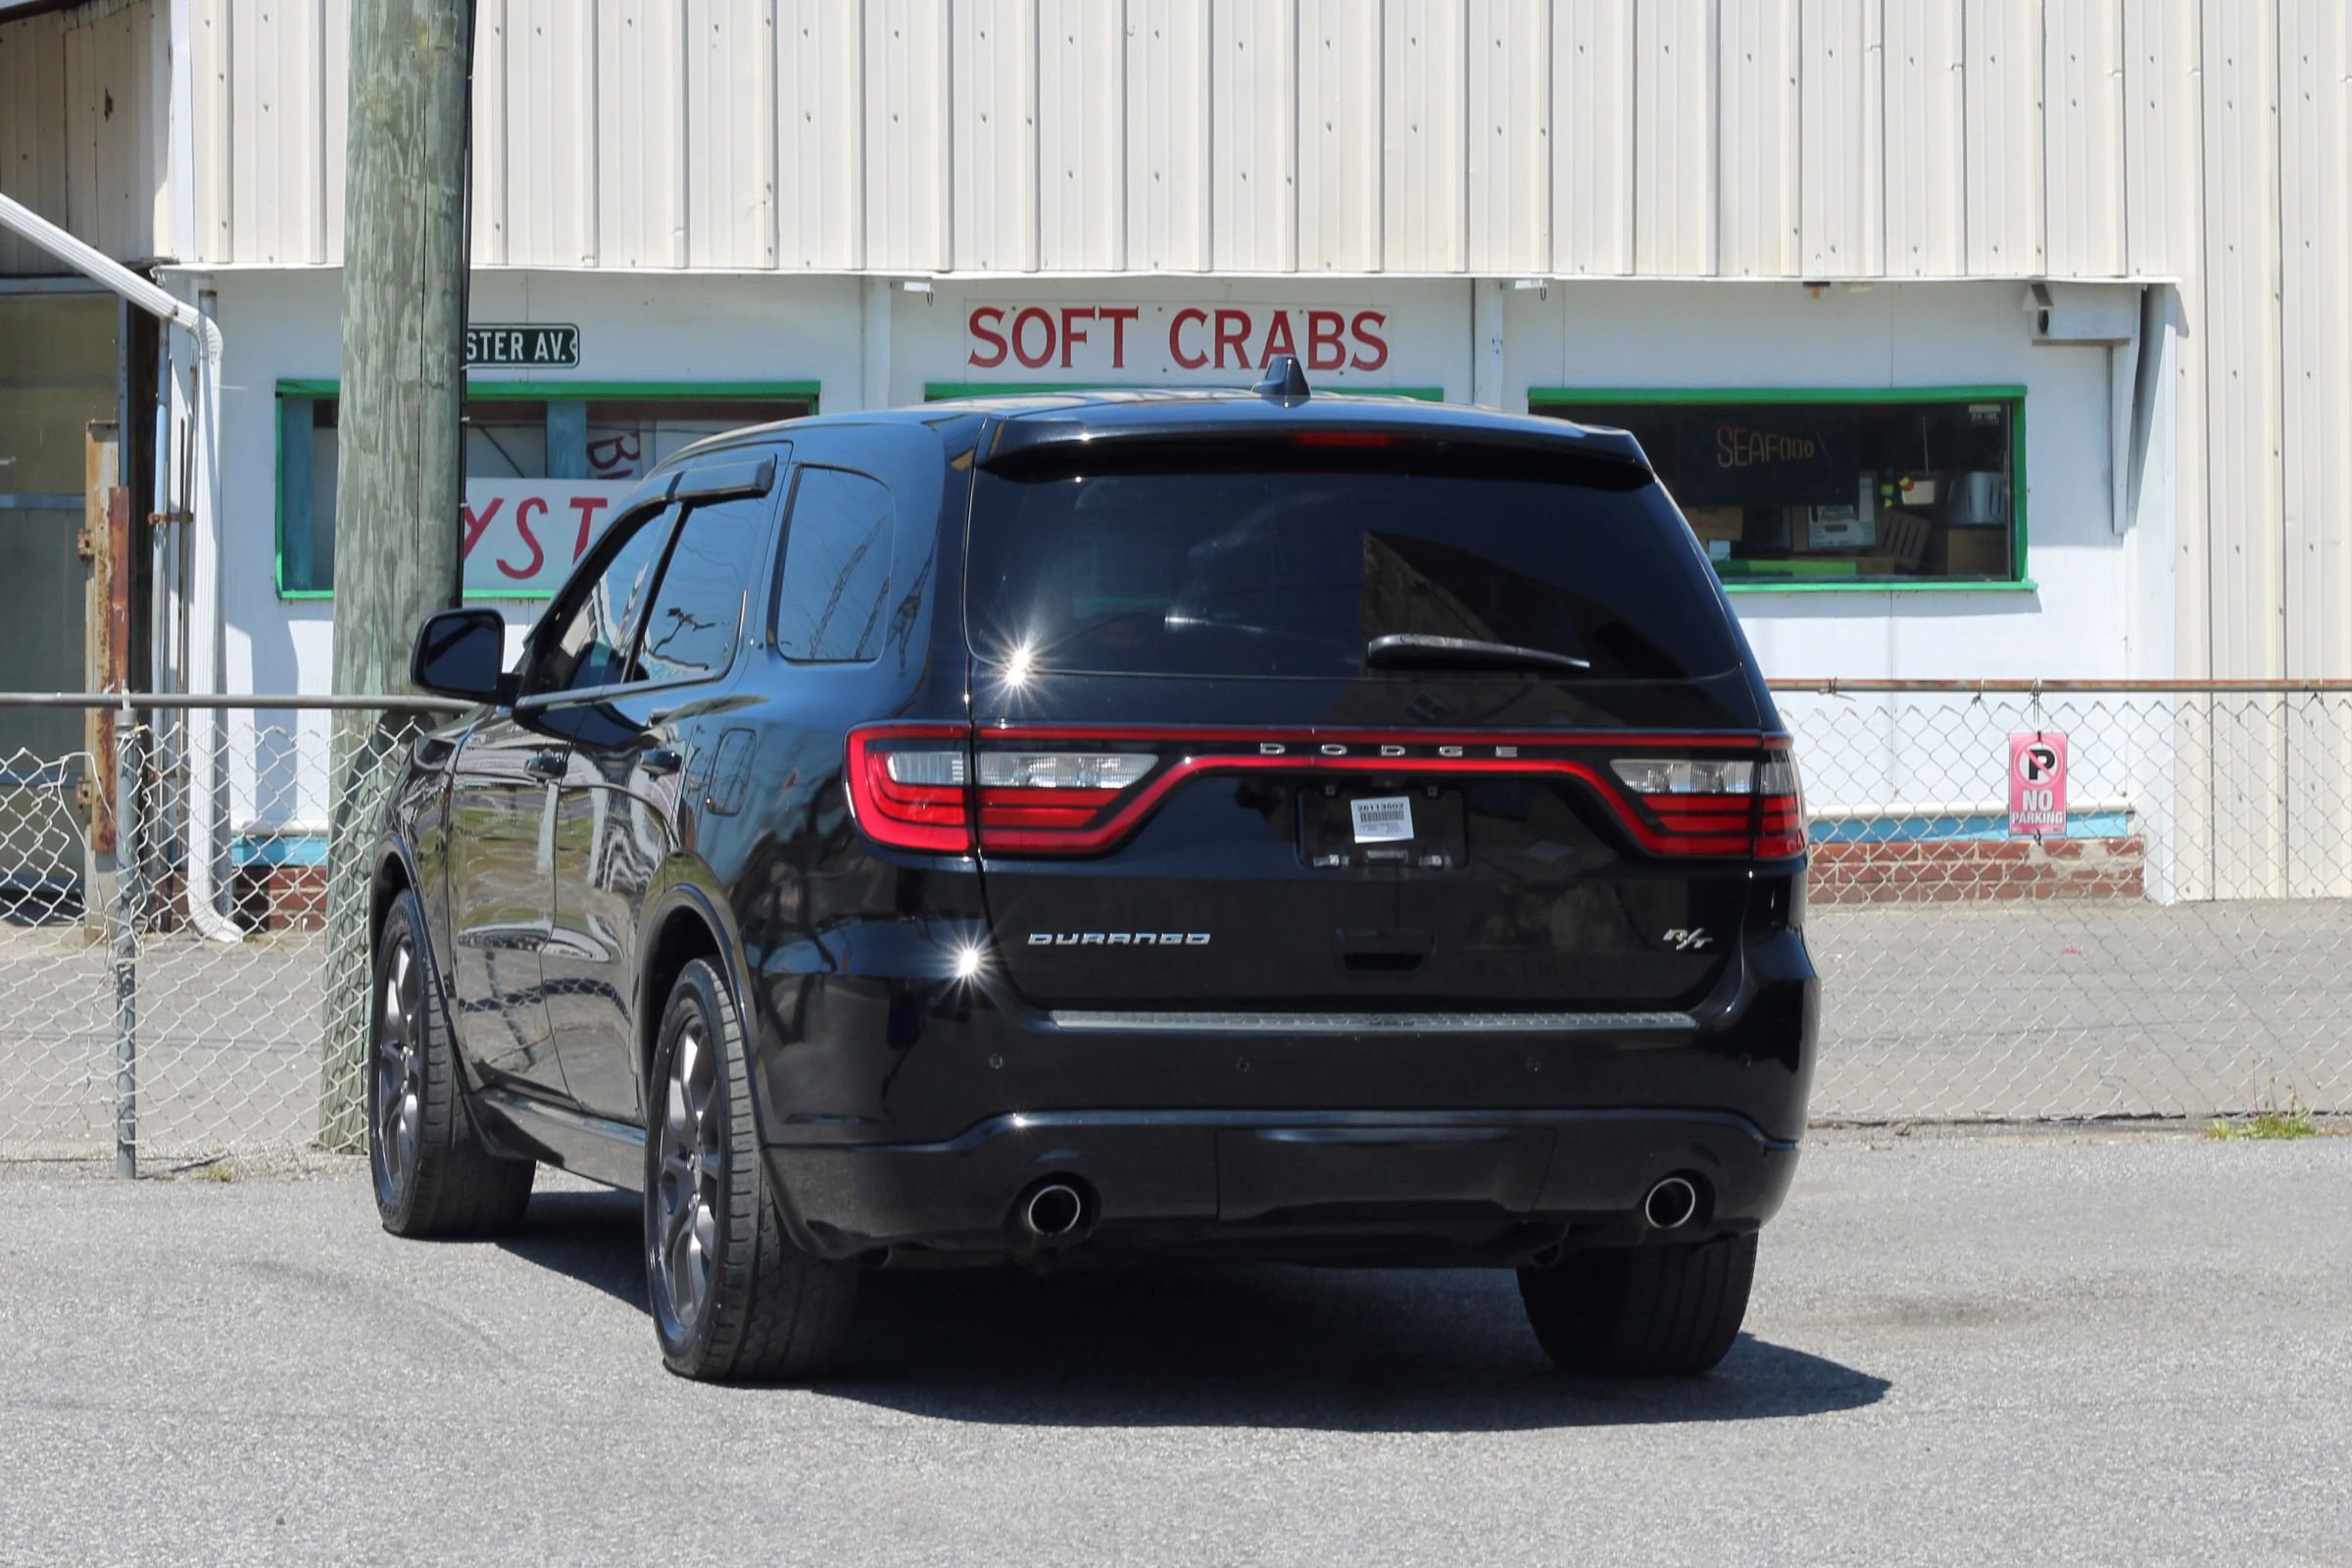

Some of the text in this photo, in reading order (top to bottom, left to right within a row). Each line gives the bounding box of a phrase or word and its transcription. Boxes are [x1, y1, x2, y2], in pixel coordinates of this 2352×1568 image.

[466, 331, 566, 361] STER AV.
[968, 306, 1389, 371] SOFT CRABS
[1717, 424, 1815, 468] SEAFOOD
[1259, 742, 1518, 758] DODGE
[2022, 789, 2054, 812] NO
[2011, 810, 2064, 824] PARKING
[1027, 933, 1211, 946] DURANGO
[1662, 927, 1714, 951] R/T
